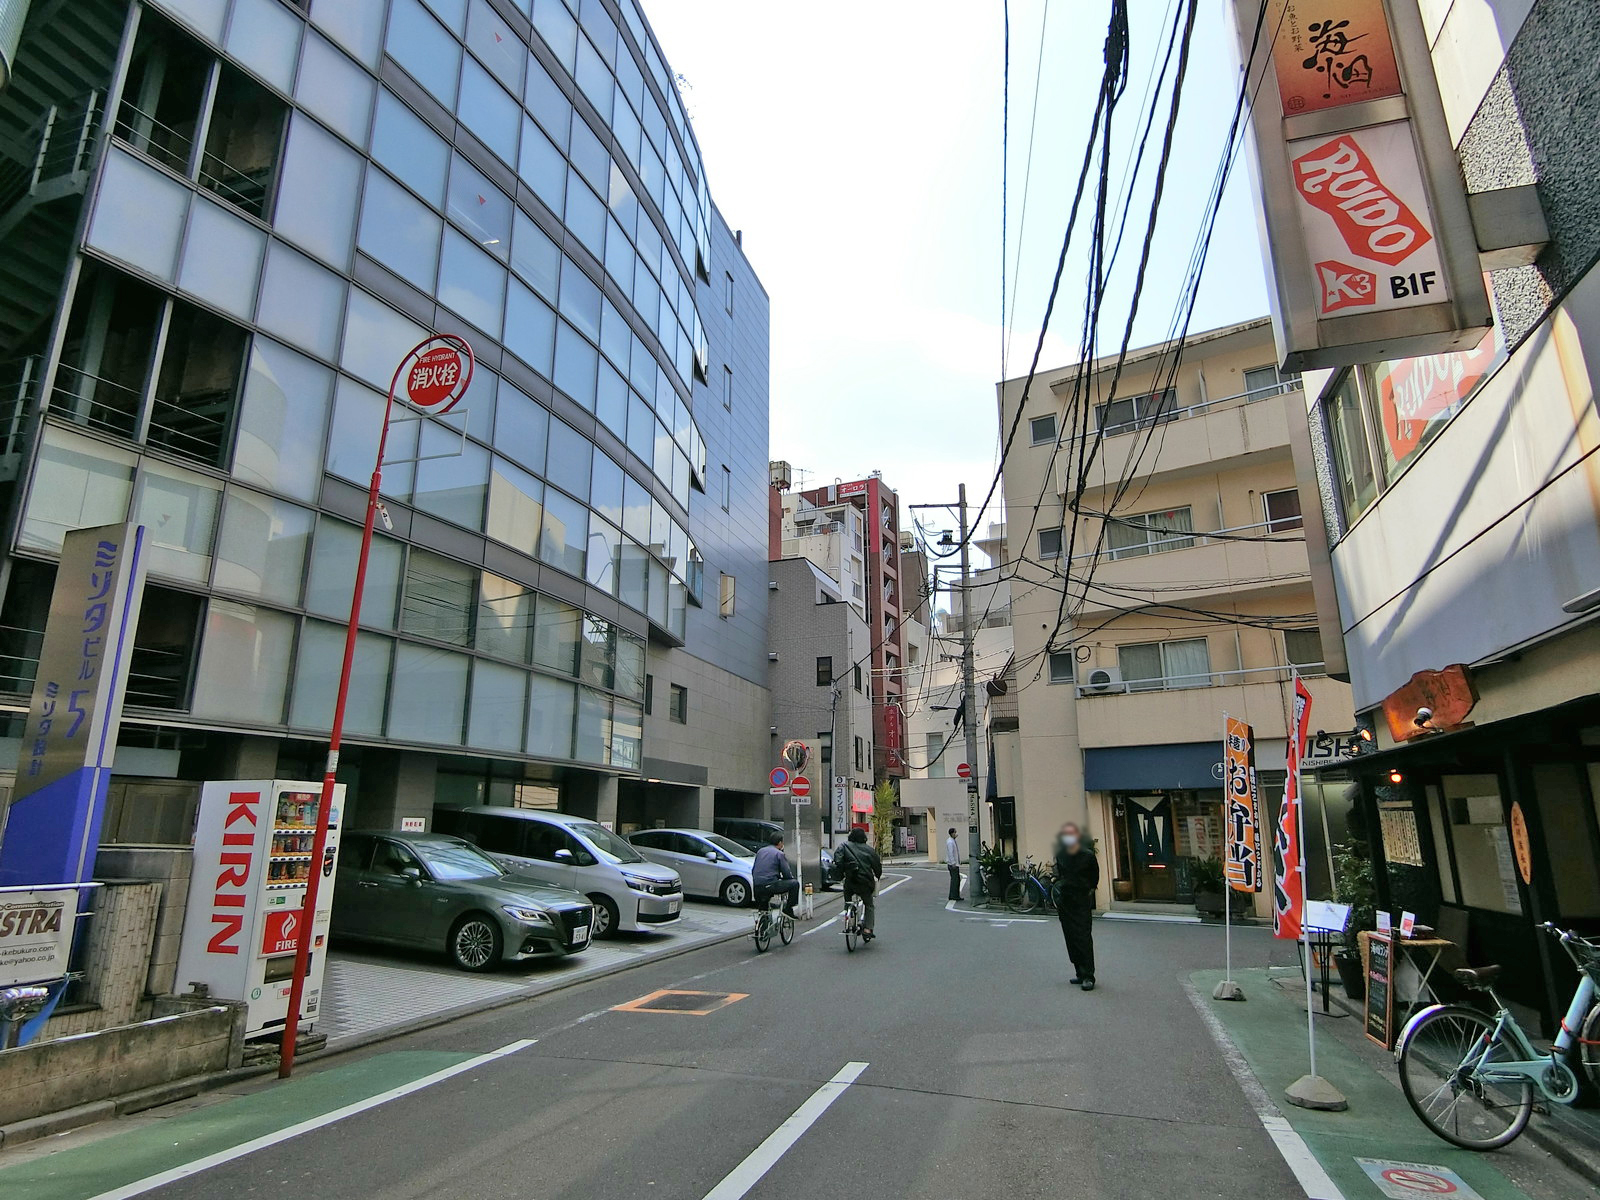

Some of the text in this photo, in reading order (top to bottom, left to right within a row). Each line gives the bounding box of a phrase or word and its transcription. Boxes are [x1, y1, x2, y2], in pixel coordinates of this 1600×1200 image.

[1300, 142, 1416, 254] RUIDO
[1390, 271, 1436, 299] B1F
[419, 352, 455, 364] FIRE HYDRANT
[411, 362, 458, 391] 消火栓
[888, 730, 897, 765] オーロラ
[1229, 757, 1255, 888] お弁当
[207, 792, 260, 954] KIRIN
[0, 908, 63, 938] STRA
[275, 939, 298, 951] FIRE
